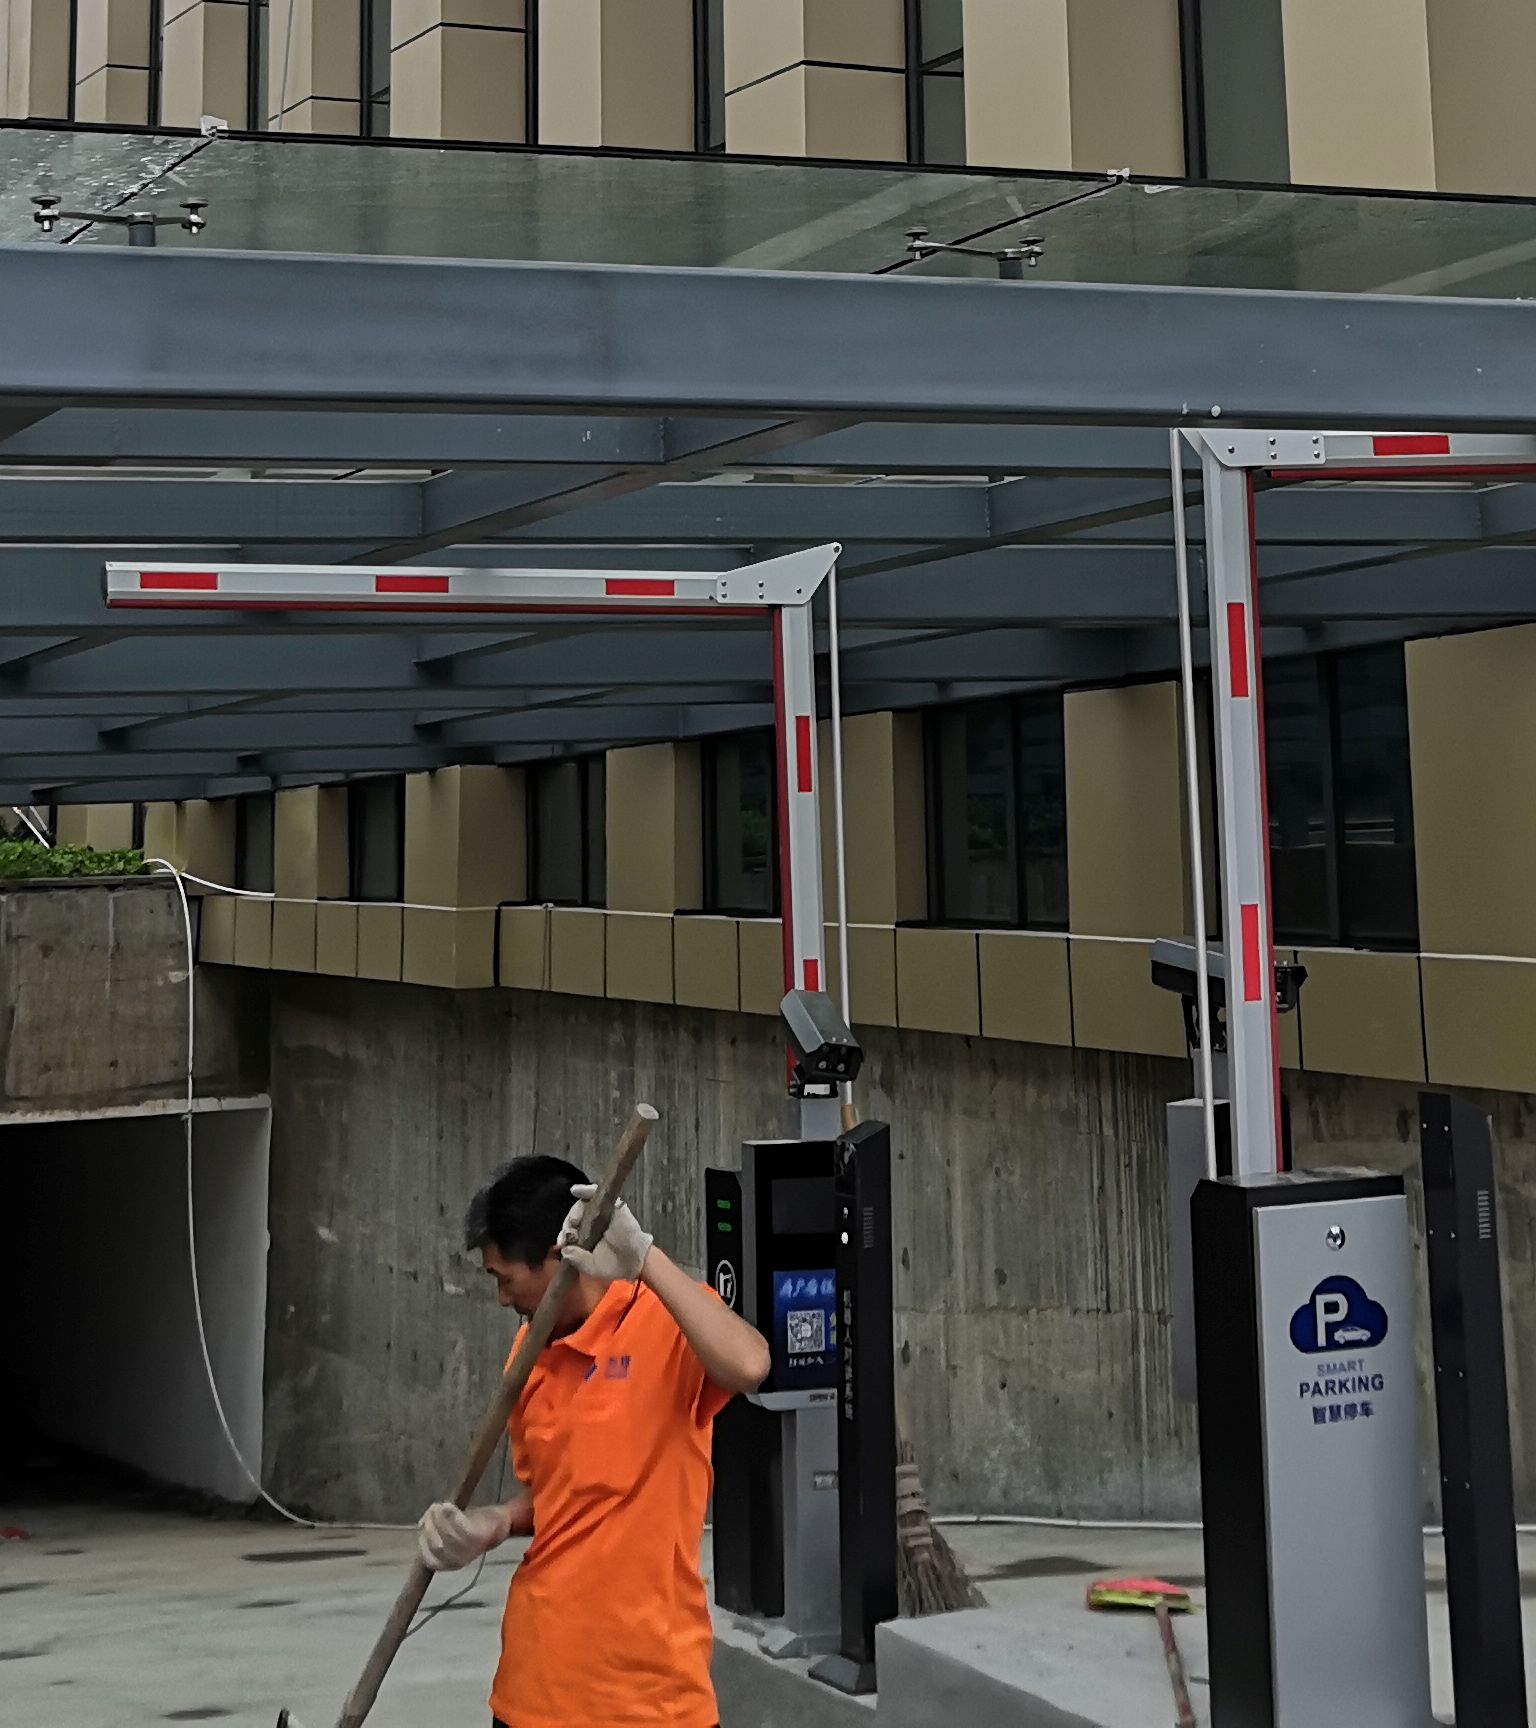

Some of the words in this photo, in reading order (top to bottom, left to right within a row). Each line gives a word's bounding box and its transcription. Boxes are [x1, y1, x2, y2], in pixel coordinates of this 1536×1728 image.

[1316, 1293, 1349, 1347] P
[1316, 1359, 1365, 1377] SMART
[1299, 1373, 1384, 1399] PARKING
